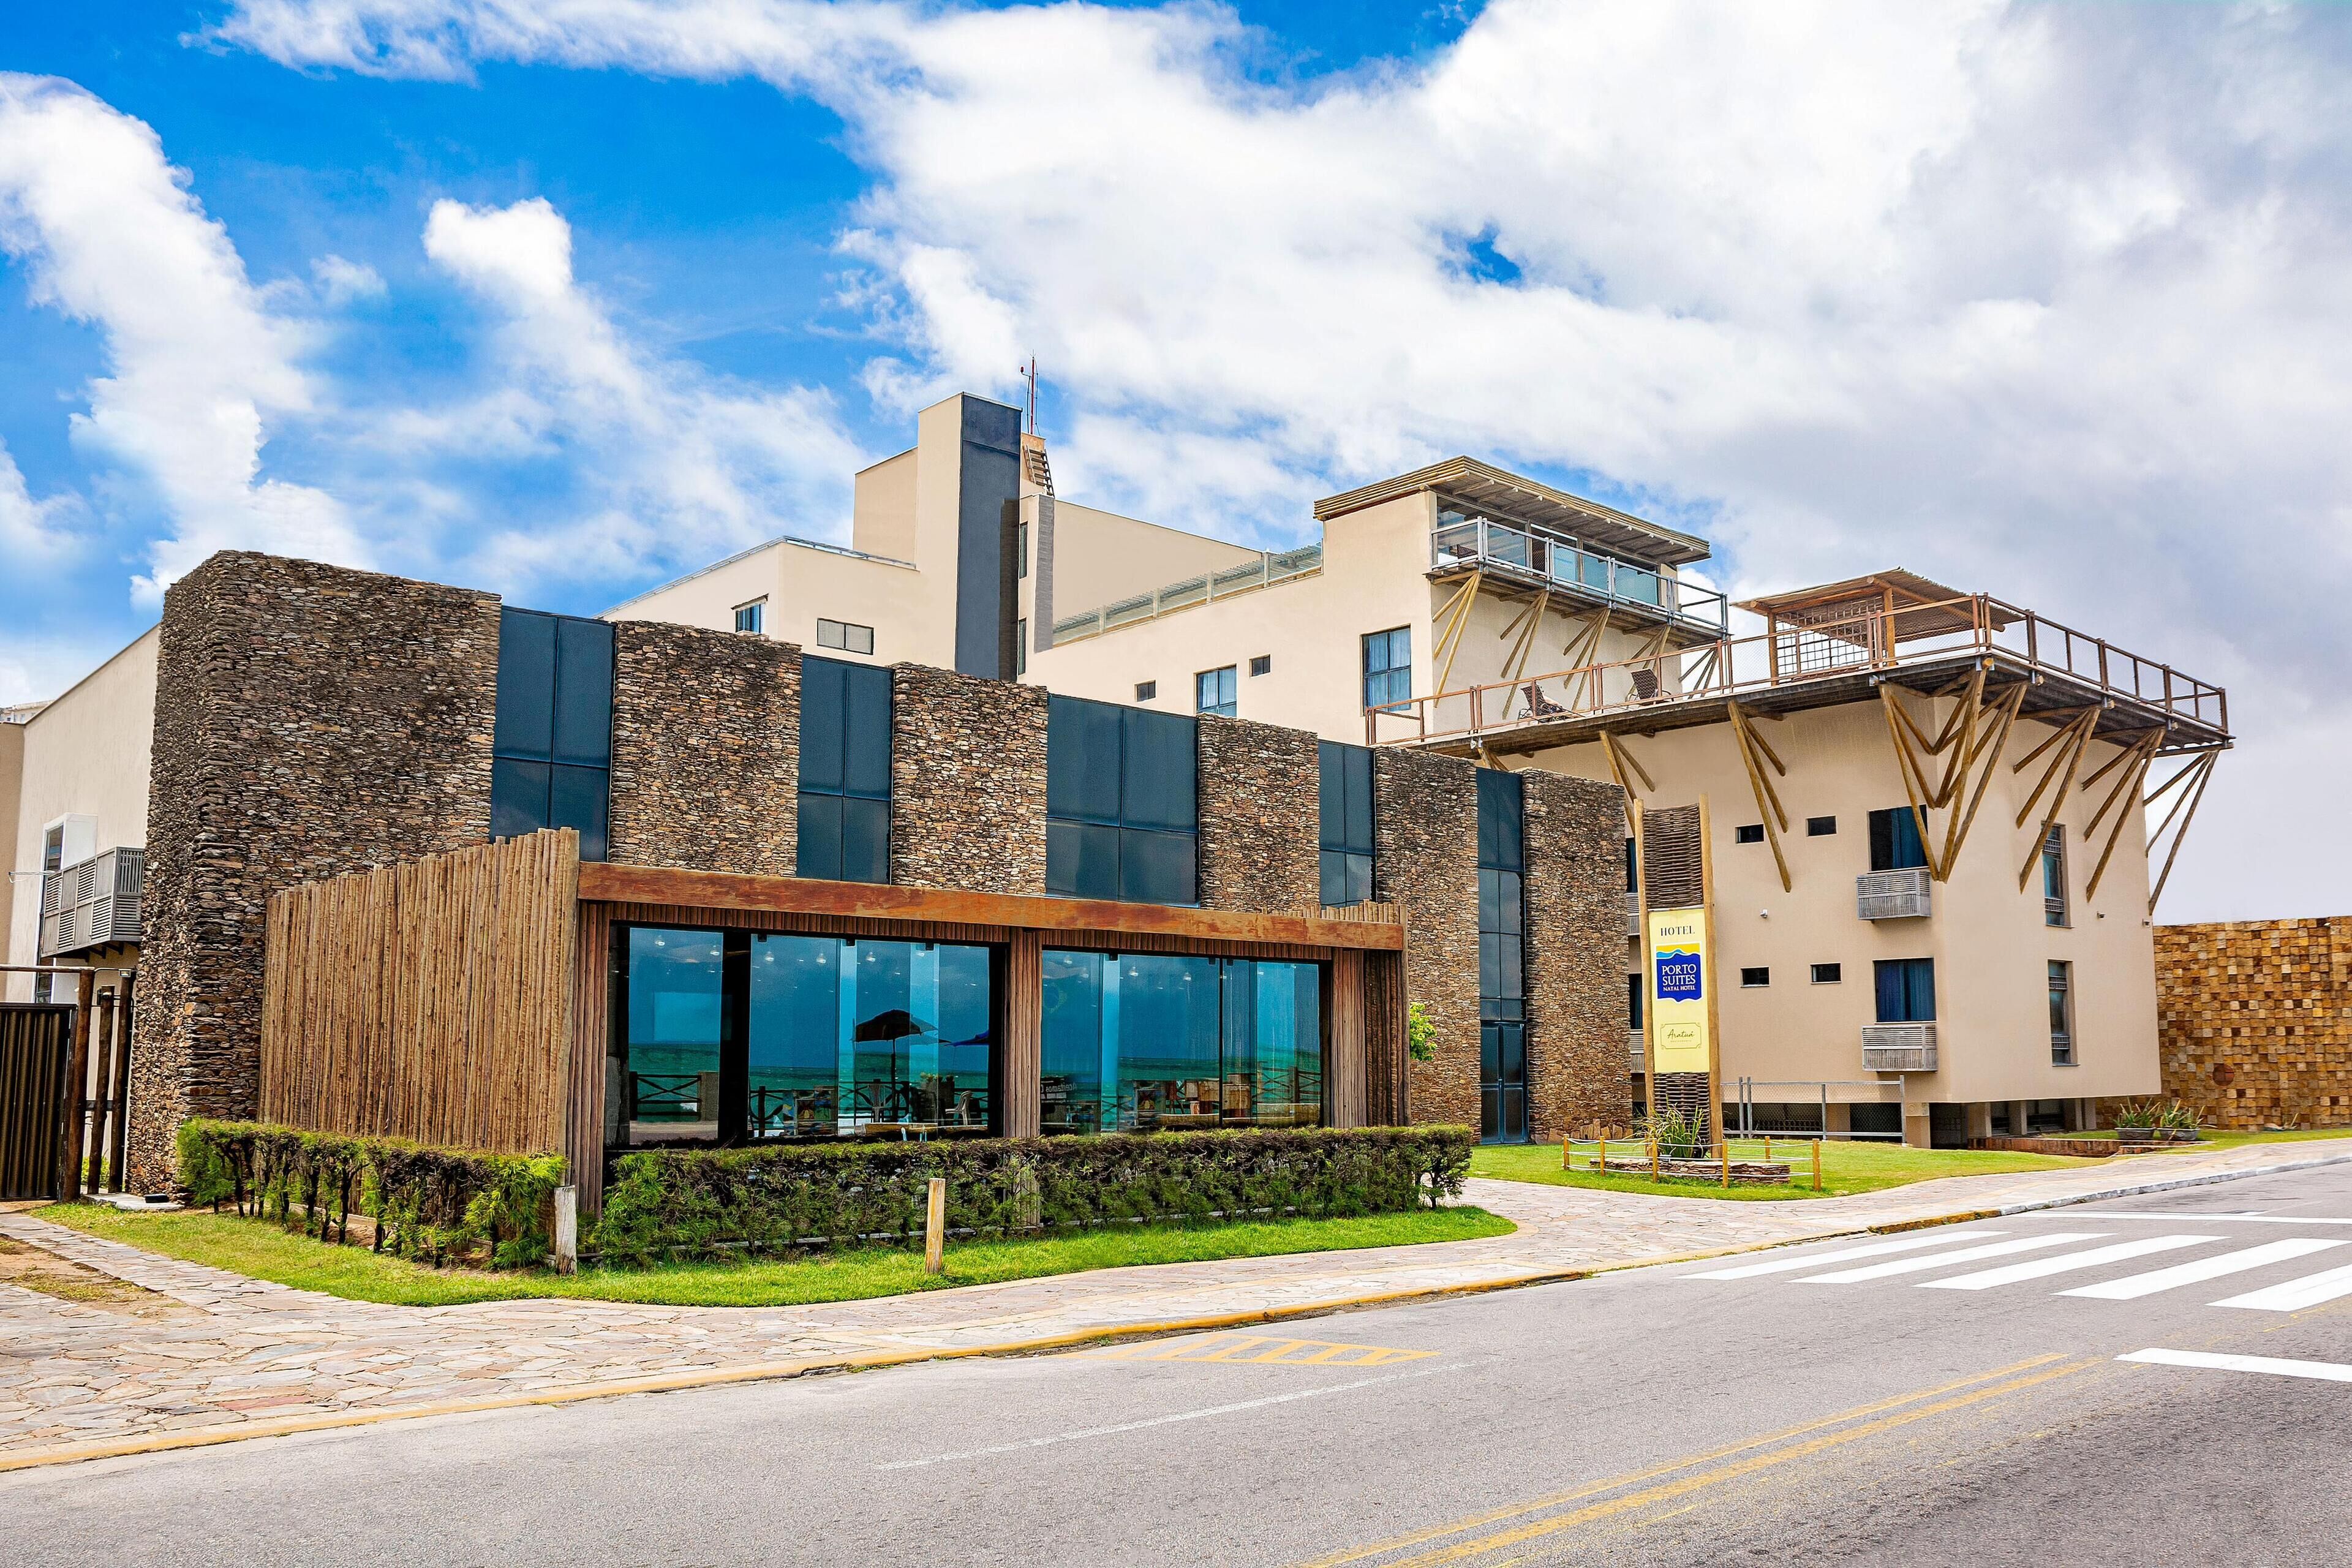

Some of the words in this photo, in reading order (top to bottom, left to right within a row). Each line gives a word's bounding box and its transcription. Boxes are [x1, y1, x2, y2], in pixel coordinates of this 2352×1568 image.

[1660, 925, 1695, 936] HOTEL
[1662, 963, 1697, 975] PORTO
[1662, 974, 1696, 986] SUITES
